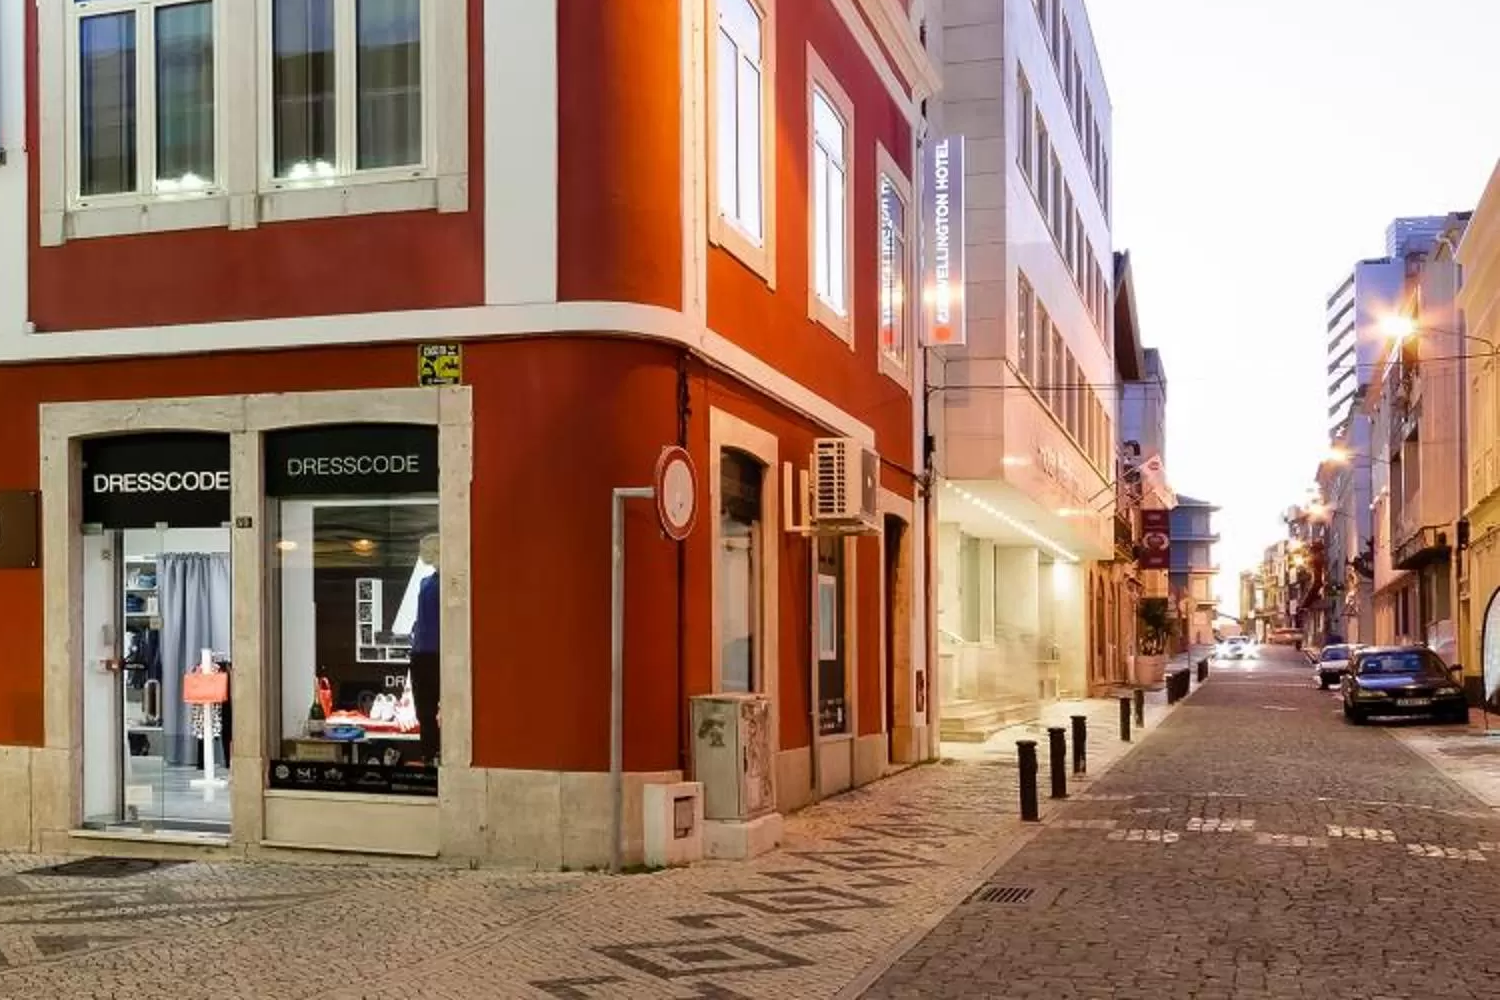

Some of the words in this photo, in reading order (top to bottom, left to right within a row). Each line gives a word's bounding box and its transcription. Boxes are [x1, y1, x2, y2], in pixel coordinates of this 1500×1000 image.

[935, 138, 949, 190] HOTEL
[287, 455, 420, 476] DRESSCODE
[93, 471, 230, 494] DRESSCODE
